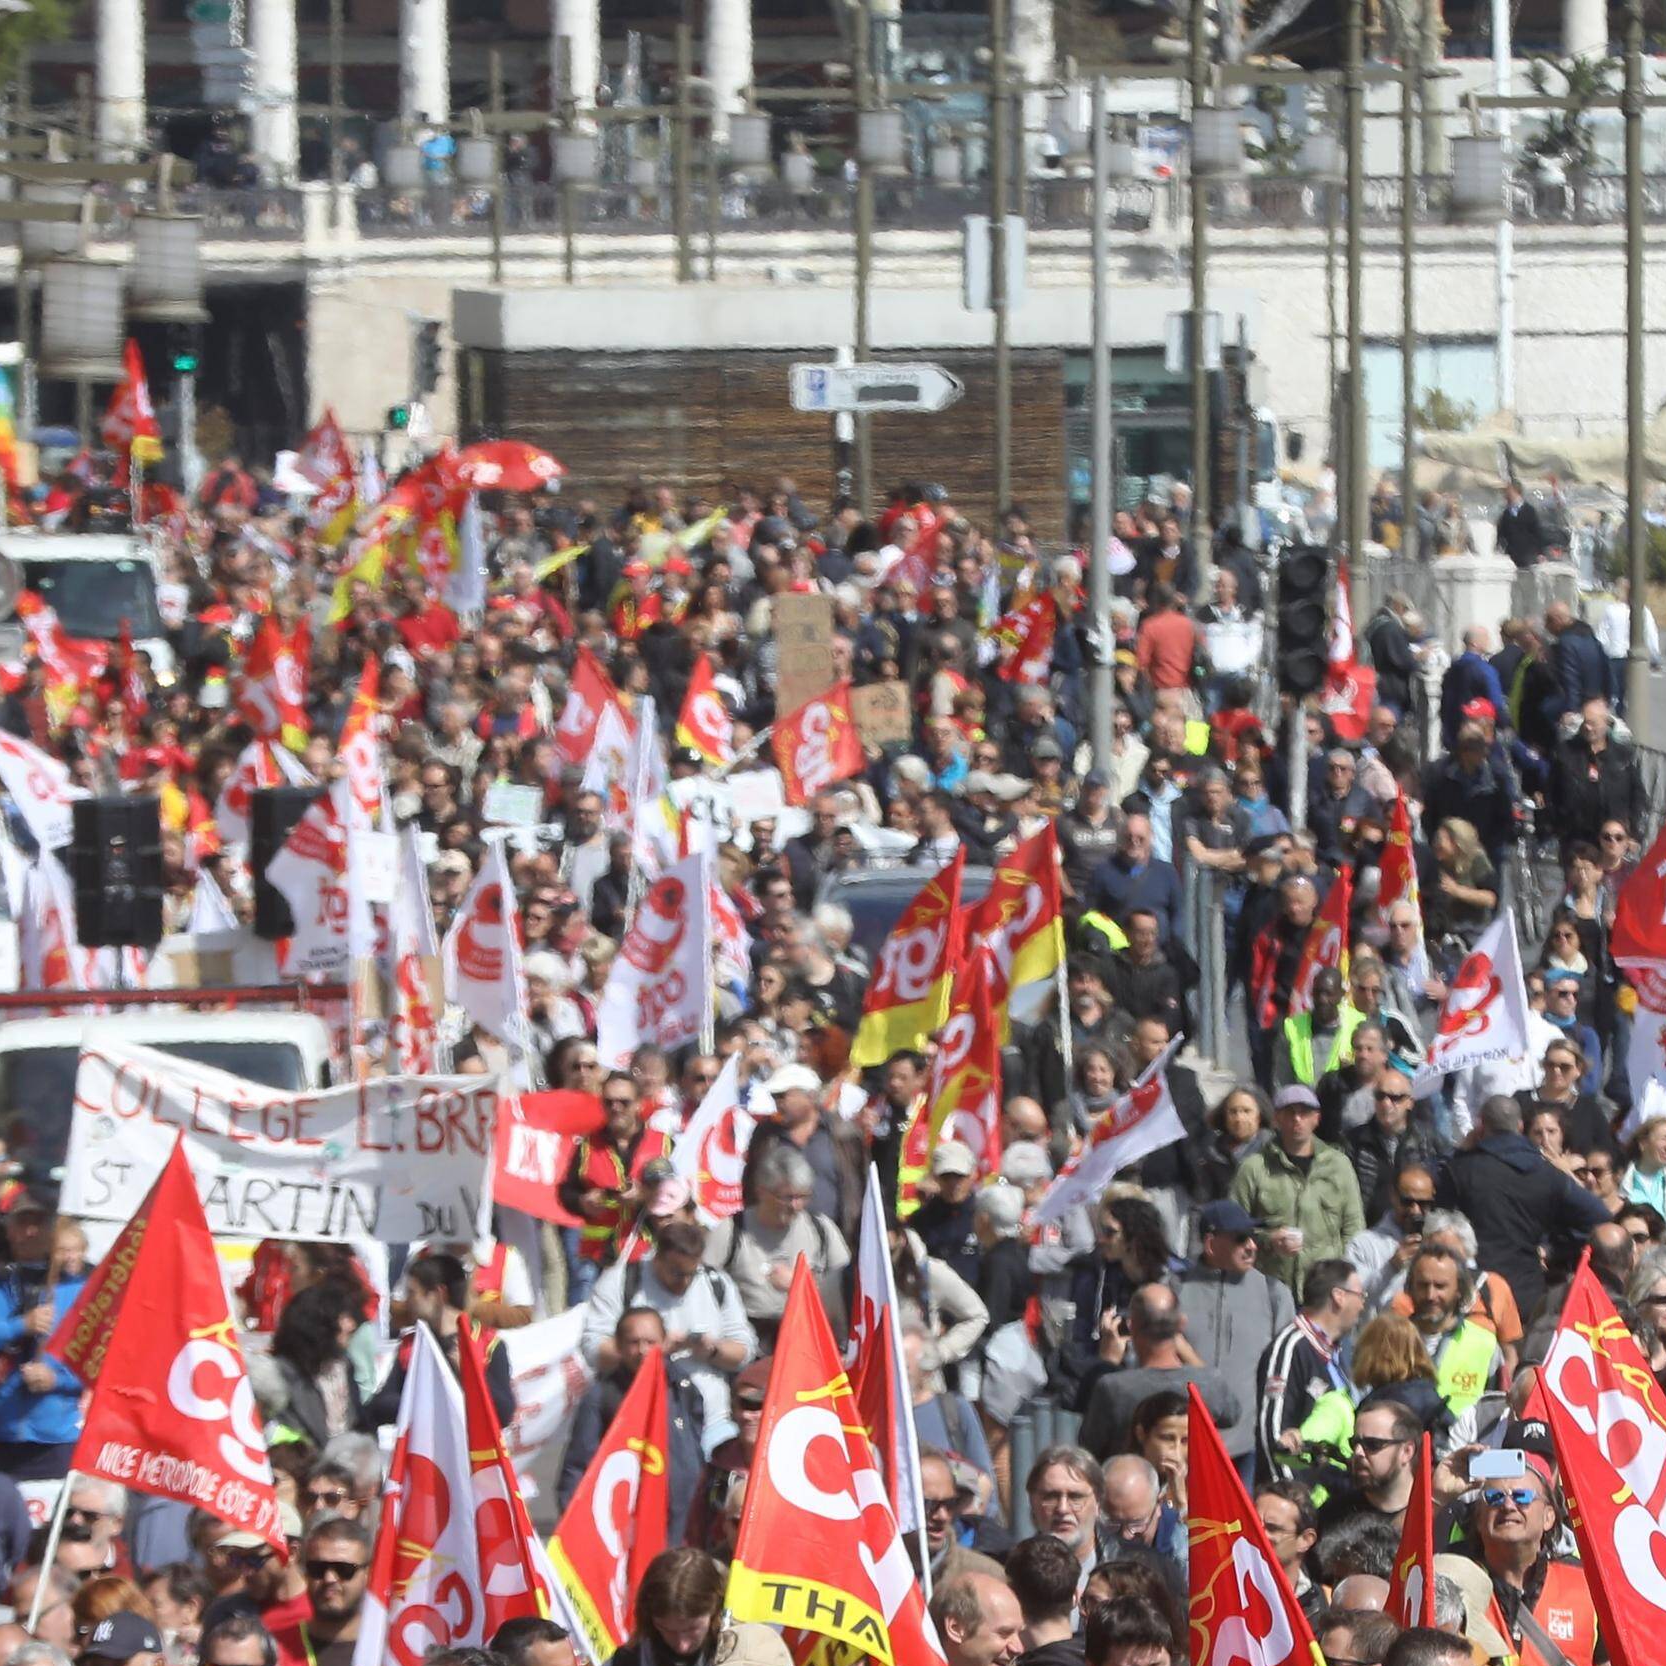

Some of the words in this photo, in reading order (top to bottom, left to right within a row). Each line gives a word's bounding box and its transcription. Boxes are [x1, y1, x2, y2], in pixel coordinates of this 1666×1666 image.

[74, 1050, 325, 1146] COLLÈGE
[202, 1174, 378, 1238] ARTIN
[416, 1202, 454, 1238] DU
